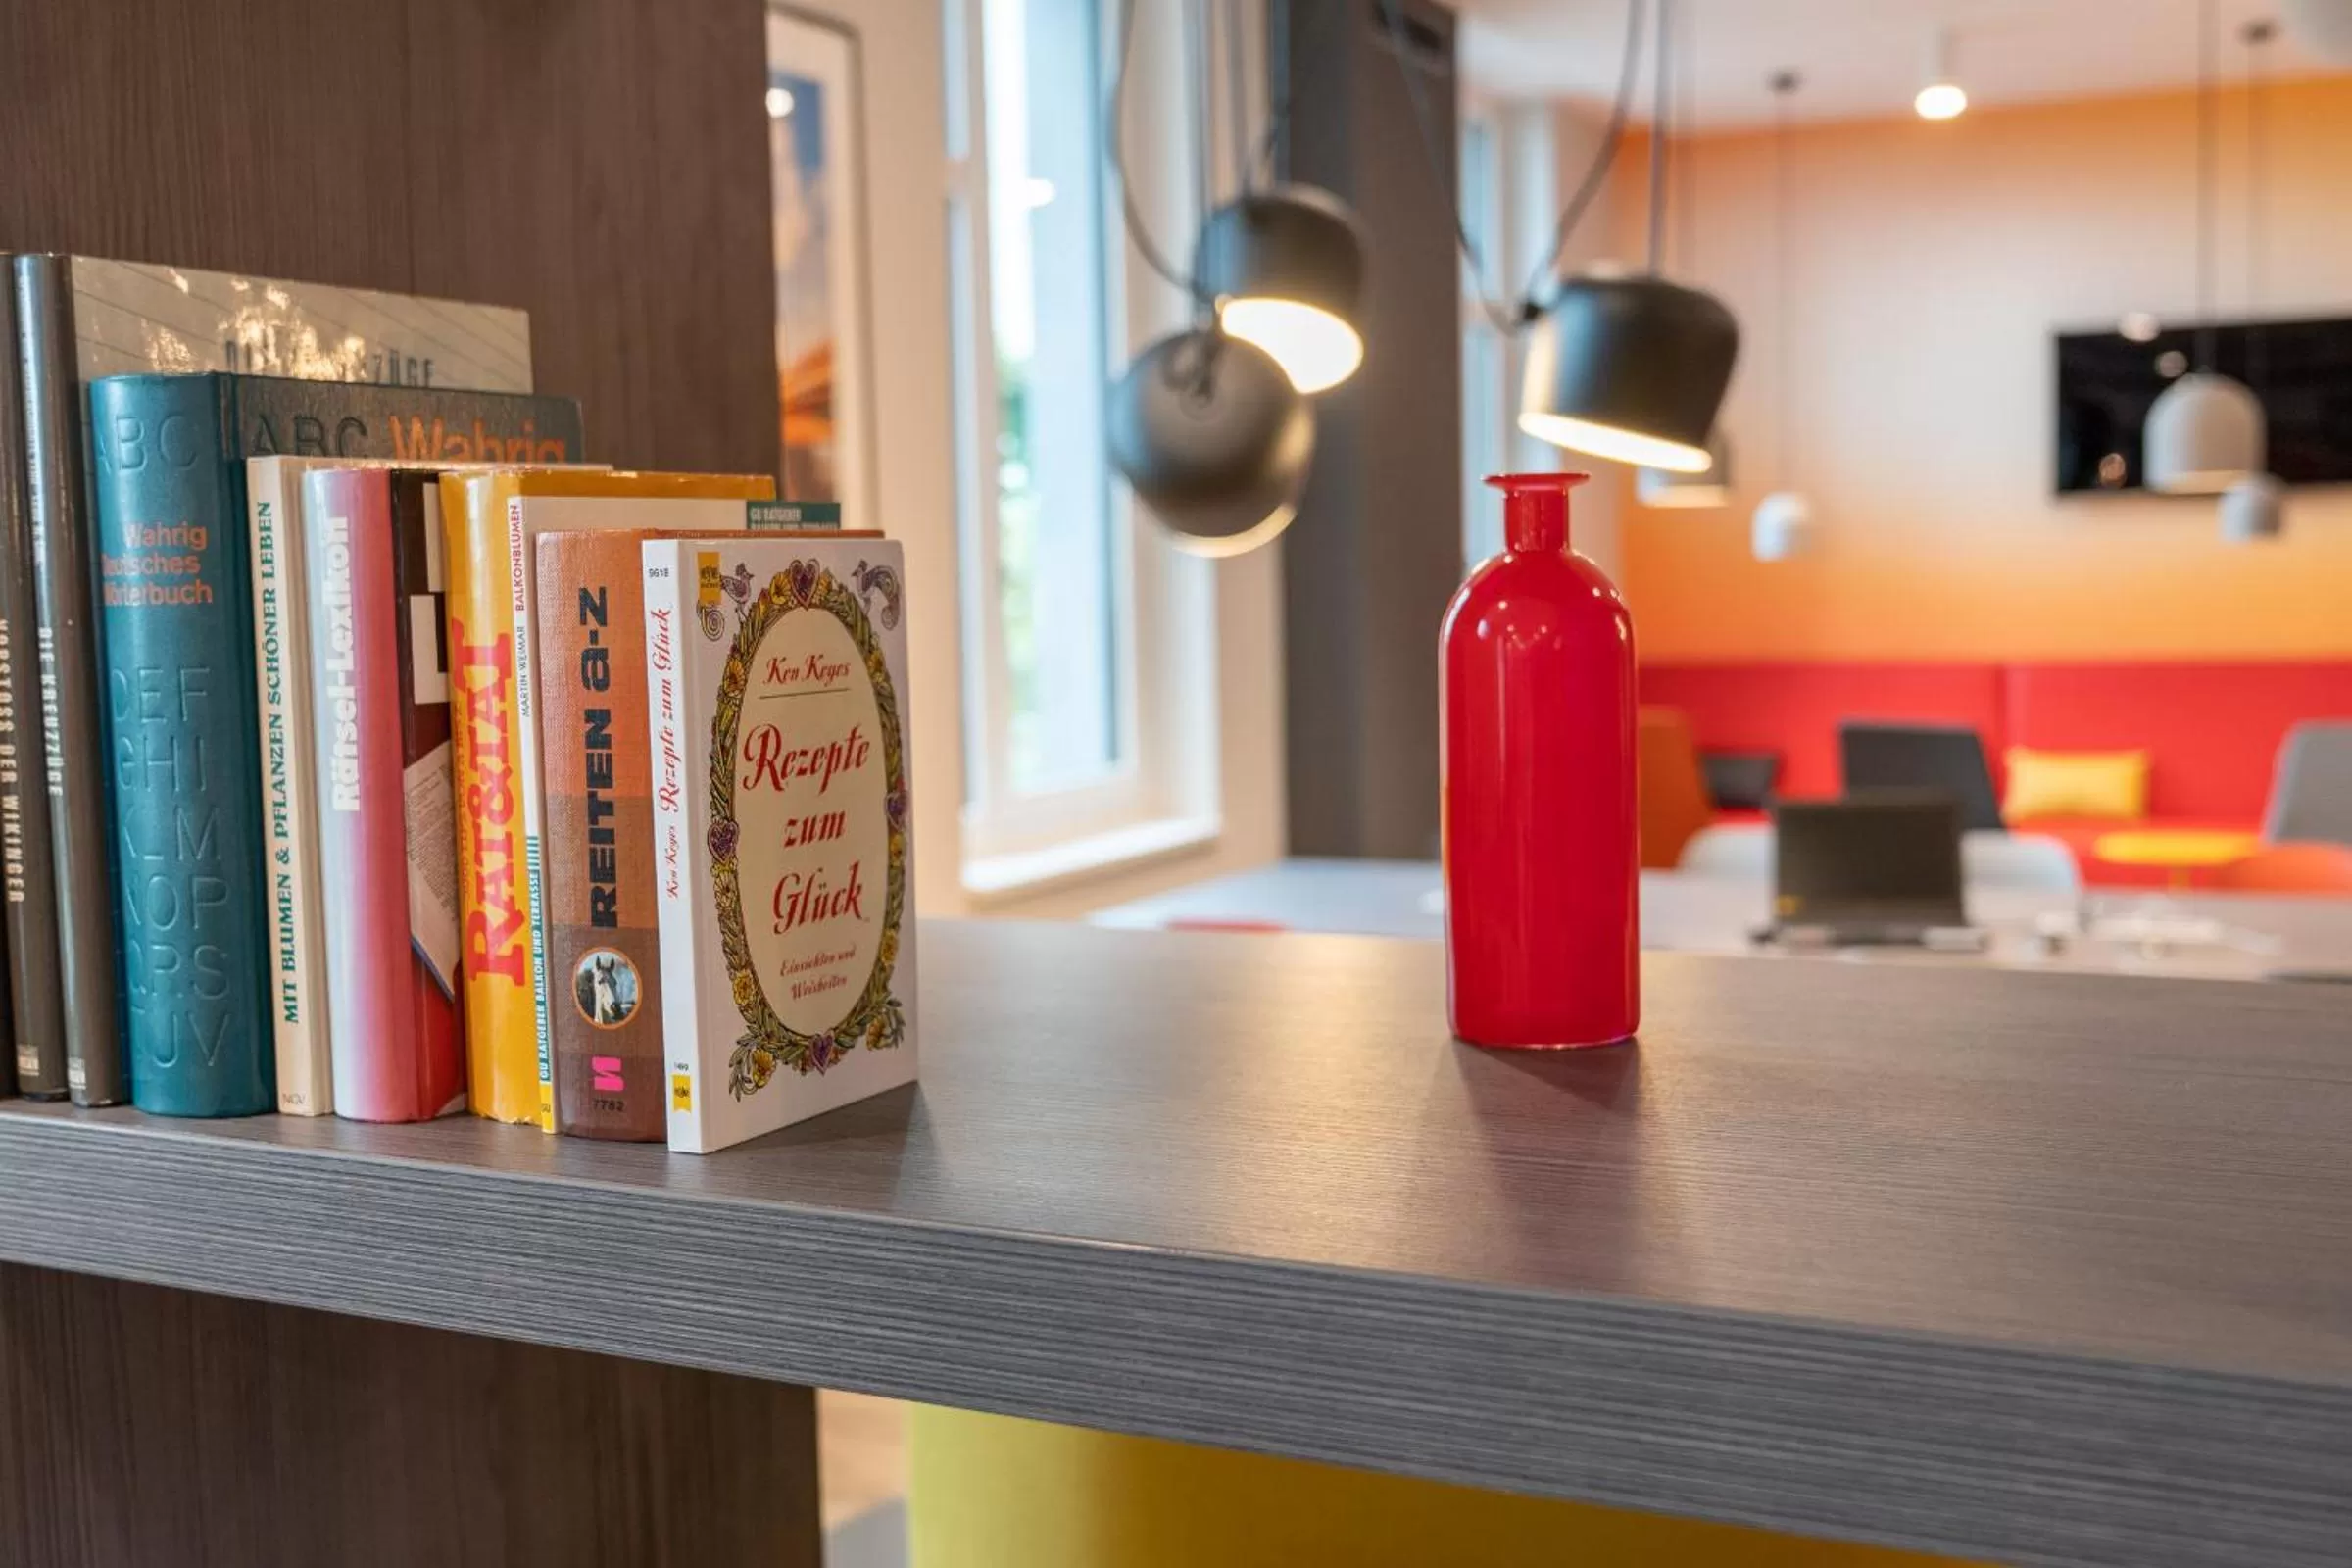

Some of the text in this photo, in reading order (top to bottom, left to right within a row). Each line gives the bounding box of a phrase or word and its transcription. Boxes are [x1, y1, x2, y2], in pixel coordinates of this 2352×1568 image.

[123, 519, 209, 551] Wahrig
[100, 553, 202, 577] eutsches
[509, 504, 526, 612] BALKONBLUMEN
[102, 578, 214, 606] örterbuch
[762, 654, 851, 687] Ken Keyes
[38, 627, 65, 797] DIE KREUZZÜGE
[519, 672, 530, 717] MARTIN
[662, 679, 674, 720] zum
[0, 744, 17, 783] DER
[257, 502, 299, 1024] MIT BLUMEN & PFLANZEN SCHÖNER LEBEN
[659, 727, 681, 813] Rezepte
[743, 723, 870, 797] Rezepte
[584, 708, 618, 929] REITEN
[783, 809, 847, 851] zum
[3, 795, 24, 902] WIKINGER
[529, 870, 541, 926] TERRASSE
[772, 861, 866, 935] Glück
[532, 930, 543, 955] UND
[779, 940, 858, 978] Einsichten und
[534, 957, 545, 1001] BALKON
[536, 1003, 548, 1059] RATGEBER
[592, 1099, 624, 1113] 7782
